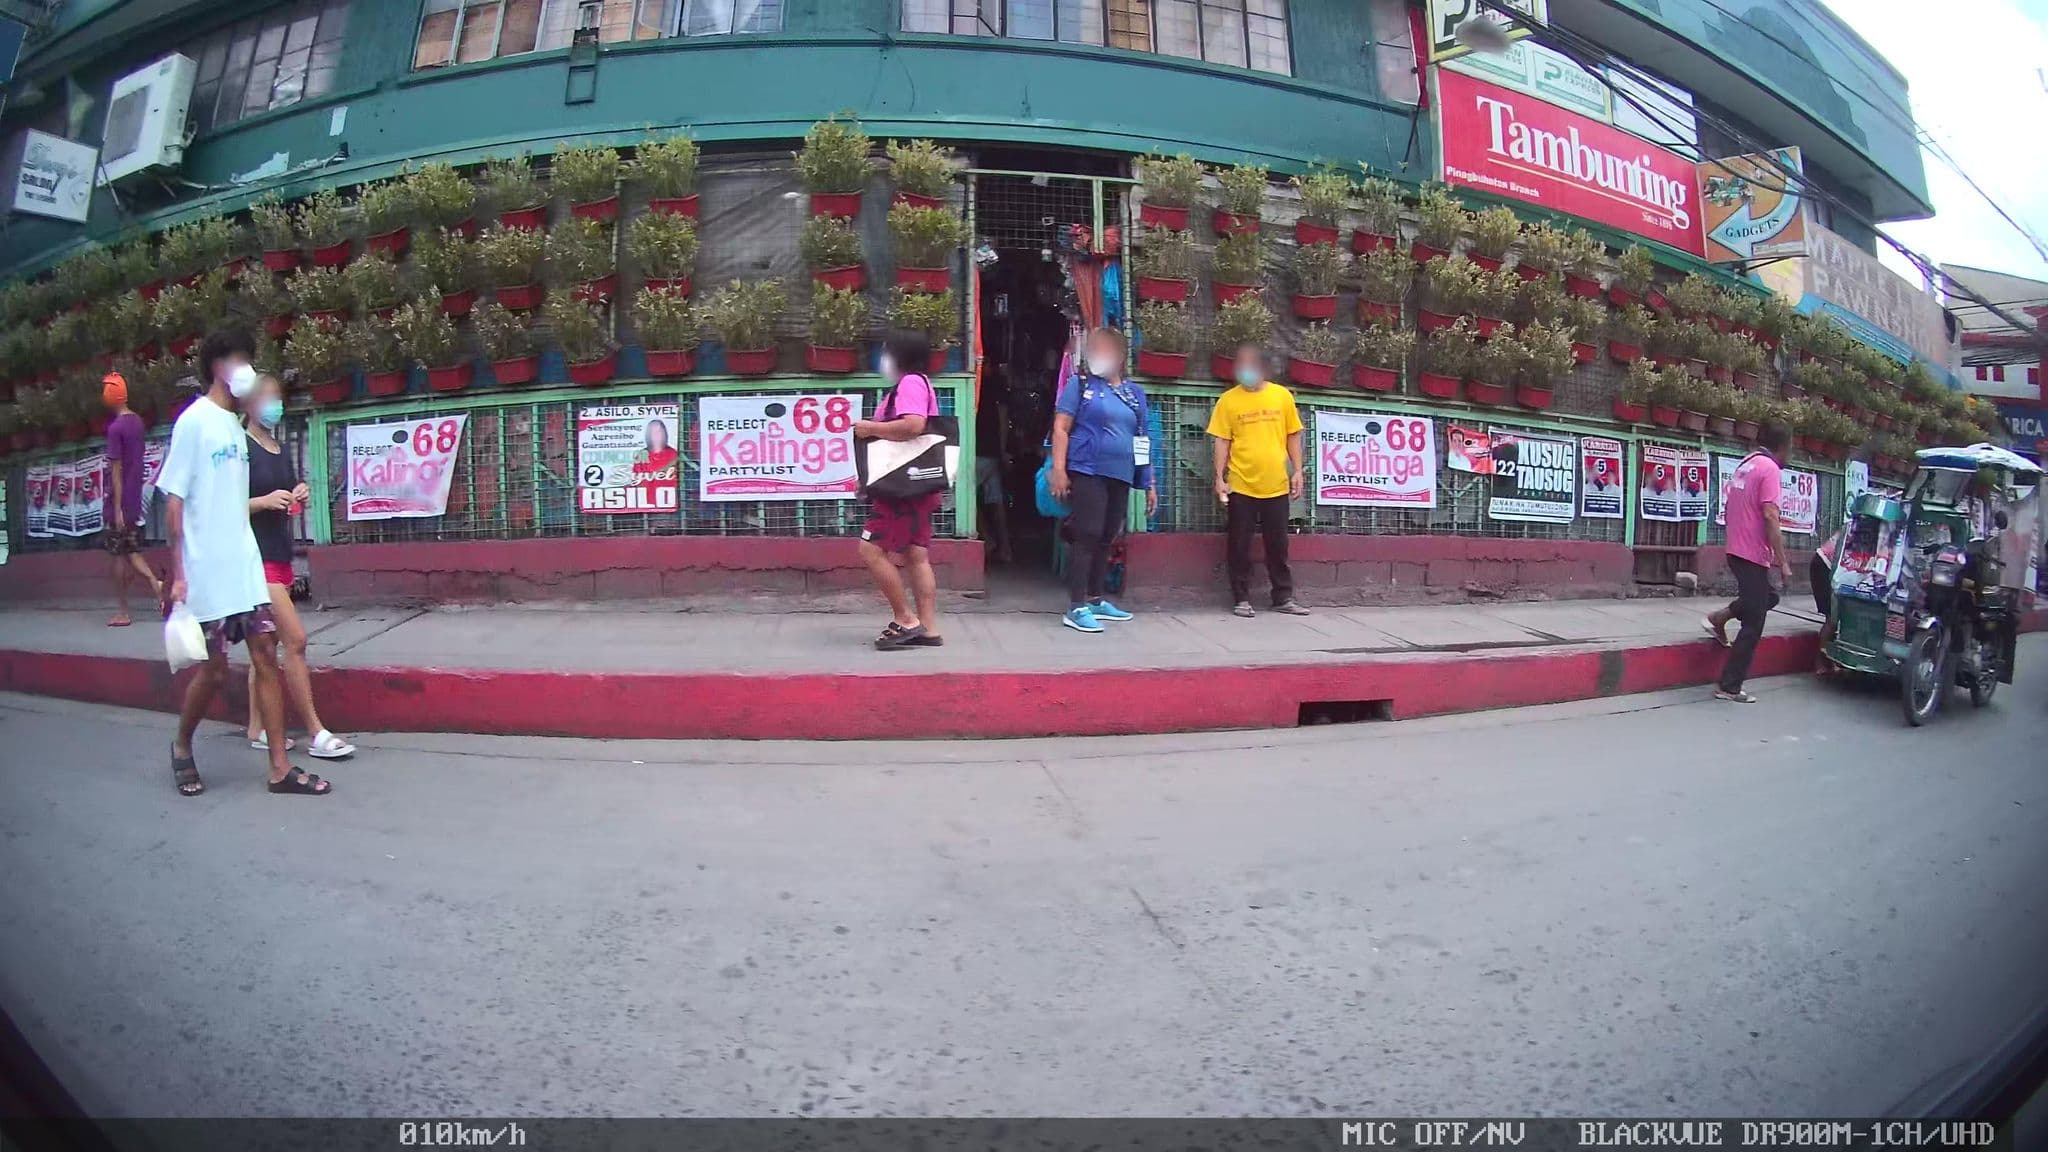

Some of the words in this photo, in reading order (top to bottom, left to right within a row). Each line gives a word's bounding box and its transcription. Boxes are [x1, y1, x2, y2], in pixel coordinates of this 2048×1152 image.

[1476, 95, 1690, 230] Tambunting
[1509, 181, 1540, 198] Branch
[1725, 216, 1780, 239] GADGETS
[638, 406, 676, 416] SYVEL
[796, 397, 851, 434] 68
[708, 418, 767, 431] RE-ELECT
[1386, 418, 1426, 452] 68
[413, 420, 457, 457] 68
[1321, 432, 1368, 443] RE-ELECT
[708, 431, 849, 474] Kalinga
[587, 466, 601, 484] 2
[607, 464, 677, 486] Syvel
[709, 465, 796, 476] PARTYLIST
[1321, 443, 1424, 485] Kalinga
[1597, 460, 1605, 472] 5
[1656, 466, 1664, 478] 5
[1322, 473, 1389, 485] PARTYLIST
[1516, 465, 1573, 493] TAUSUG
[1799, 475, 1812, 497] 68
[582, 487, 676, 508] ASILO
